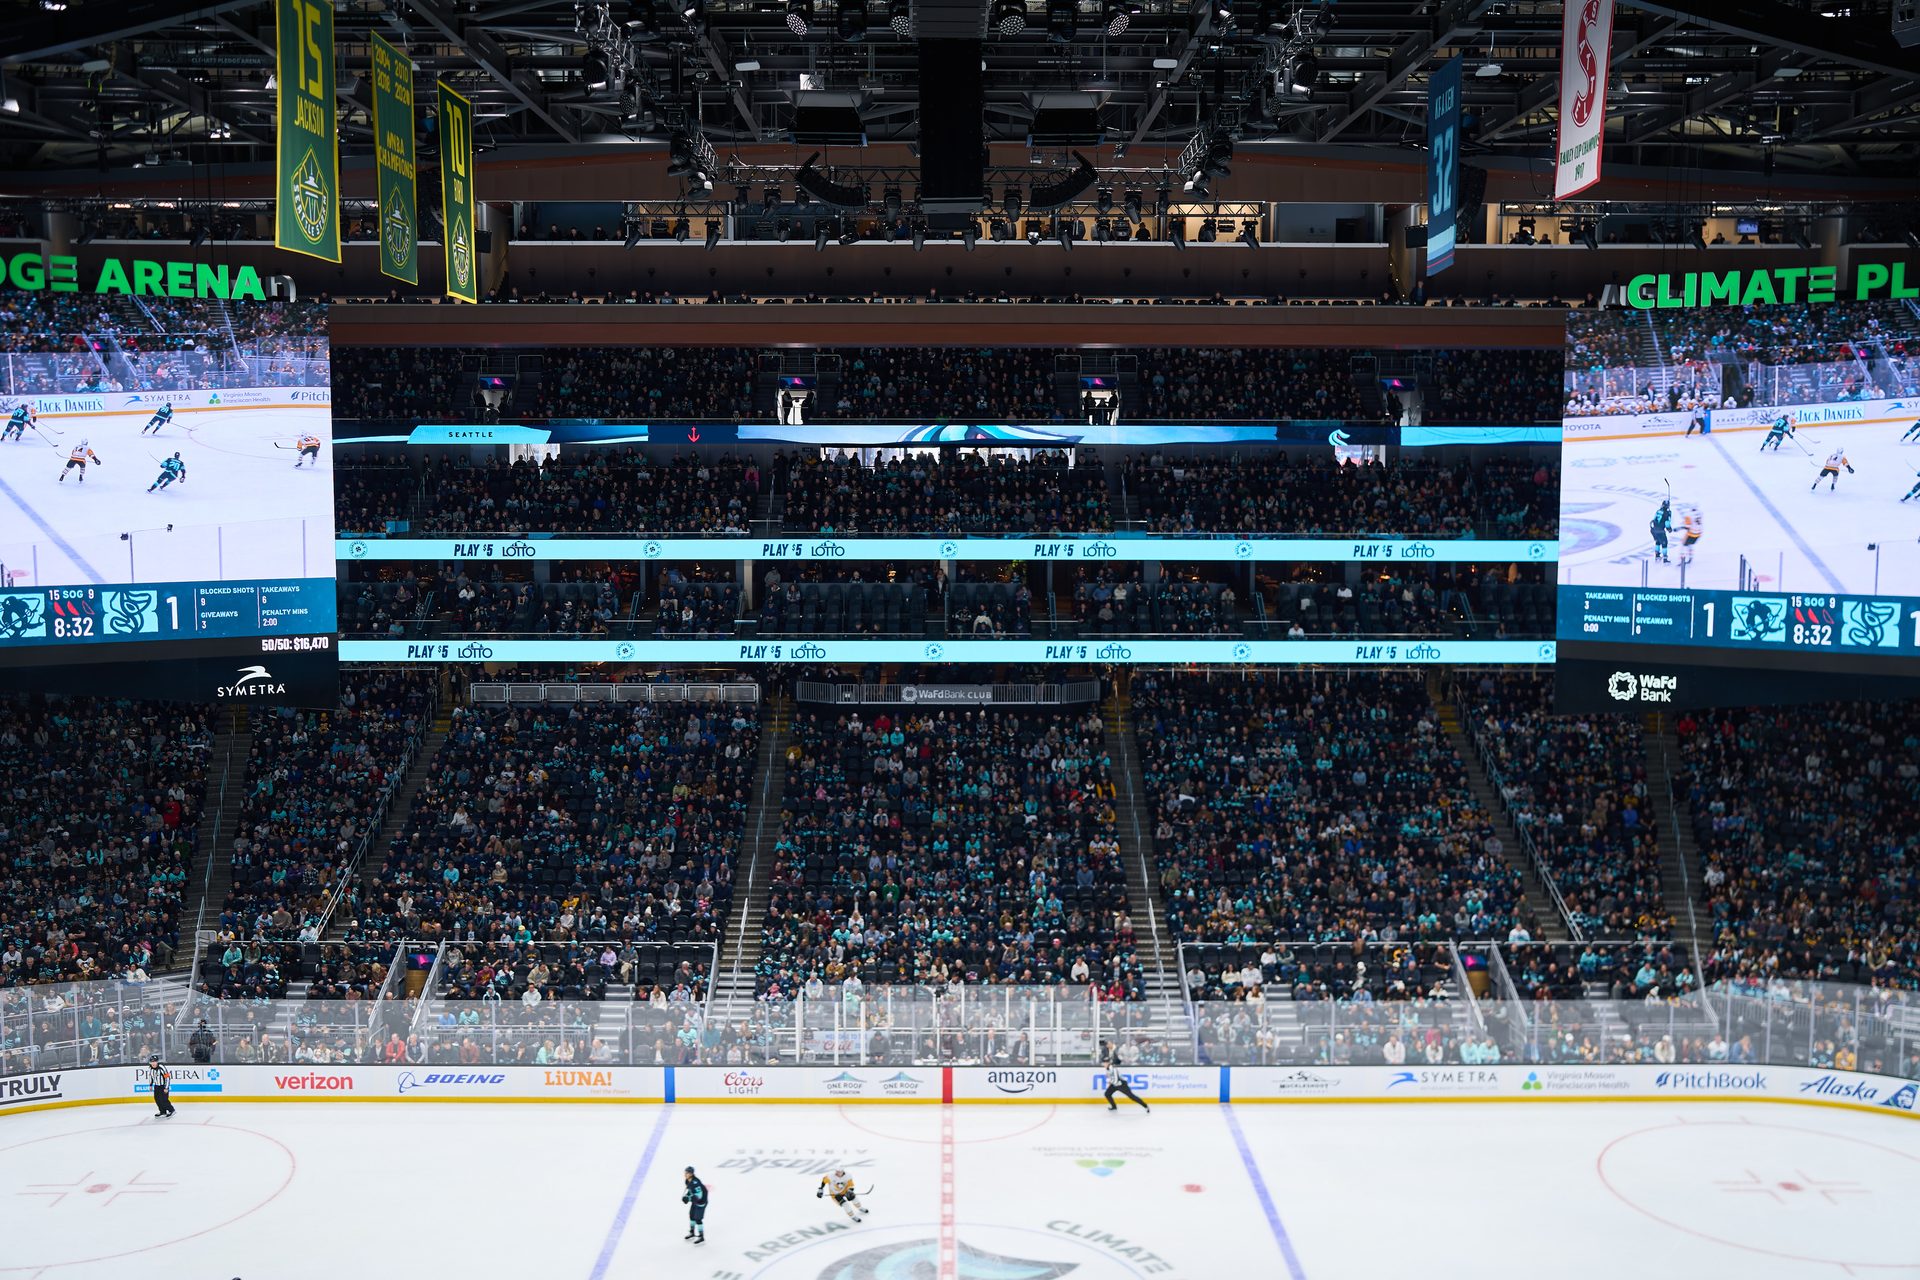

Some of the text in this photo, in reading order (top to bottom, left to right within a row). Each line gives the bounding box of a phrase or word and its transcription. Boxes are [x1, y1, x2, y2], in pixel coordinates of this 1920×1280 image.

[293, 0, 323, 100] 15
[294, 95, 324, 138] JACKSON
[446, 99, 466, 177] 10
[1432, 125, 1454, 217] 32
[0, 252, 267, 301] GE ARENA
[1627, 265, 1837, 310] CLIMATE
[1564, 423, 1601, 431] TOYOTA
[454, 544, 479, 557] PLAY
[502, 545, 536, 558] LOTTO
[763, 544, 788, 557] PLAY
[811, 545, 845, 558] LOTTO
[1035, 544, 1060, 557] PLAY
[1083, 545, 1117, 558] LOTTO
[1353, 544, 1379, 557] PLAY
[1401, 545, 1435, 558] LOTTO
[49, 588, 95, 600] 15 SOG 9
[262, 595, 267, 604] 6
[1585, 592, 1623, 600] TAKEAWAYS
[1637, 594, 1668, 602] BLOCKED
[1584, 600, 1590, 610] 3
[1791, 596, 1836, 609] 15 SOG 9
[166, 596, 179, 630] 1
[1584, 615, 1613, 623] PENALTY
[1703, 602, 1715, 638] 1
[54, 616, 95, 638] 8:32
[201, 620, 207, 629] 3
[263, 618, 278, 626] 2:00
[1583, 623, 1599, 632] 0:00
[1636, 617, 1673, 625] GIVEAWAYS
[1793, 623, 1832, 646] 8:32
[1910, 610, 1920, 648] 1
[261, 637, 329, 651] 50/50: $16,470
[408, 645, 434, 658] PLAY
[458, 646, 492, 659] LOTTO
[741, 645, 767, 658] PLAY
[791, 646, 825, 659] LOTTO
[1046, 645, 1072, 658] PLAY
[1096, 646, 1131, 659] LOTTO
[1356, 645, 1382, 658] PLAY
[1406, 646, 1440, 659] LOTTO
[1639, 674, 1677, 690] WaFd
[217, 683, 286, 697] SYMETRA
[918, 689, 992, 699] WaFd Bank CLUB
[1640, 688, 1671, 702] Bank
[274, 1071, 353, 1090] verizon
[424, 1074, 506, 1085] BOEING
[544, 1070, 612, 1087] LiUNA!
[723, 1071, 764, 1087] Coors
[987, 1069, 1057, 1084] amazon
[1421, 1071, 1498, 1083] SYMETRA
[1673, 1071, 1767, 1090] PitchBook
[0, 1074, 61, 1099] TRULY
[728, 1086, 760, 1094] LIGHT
[1799, 1075, 1879, 1101] Alaska
[744, 1221, 849, 1263] ARENA
[1046, 1219, 1175, 1274] CLIMATE
